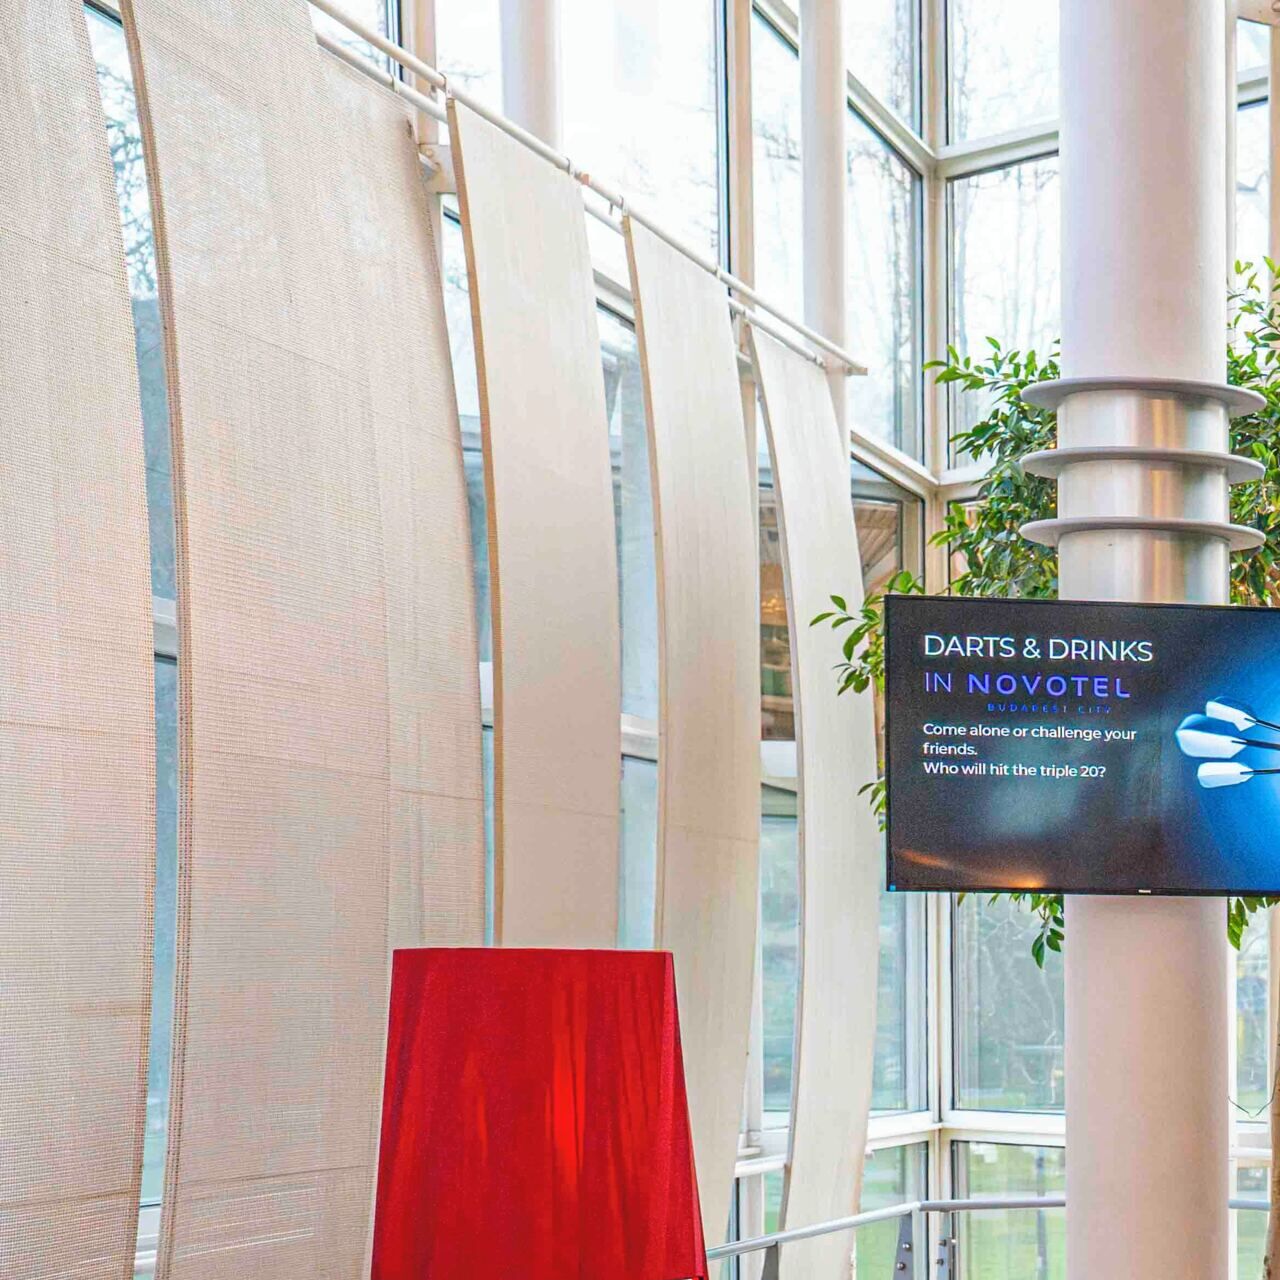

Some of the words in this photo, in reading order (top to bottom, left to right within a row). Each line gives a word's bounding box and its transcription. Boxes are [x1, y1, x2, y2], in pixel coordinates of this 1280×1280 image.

[924, 634, 1016, 660] DARTS
[1022, 638, 1041, 660] &
[1048, 638, 1153, 663] DRINKS
[924, 671, 952, 693] IN
[967, 672, 1131, 699] NOVOTEL
[923, 724, 967, 737] Come
[969, 724, 1008, 738] alone
[1011, 728, 1028, 739] or
[1031, 725, 1101, 743] challenge
[1103, 729, 1137, 744] your
[923, 742, 977, 756] friends.
[923, 762, 958, 775] Who
[960, 762, 986, 776] will
[989, 762, 1009, 776] hit
[1010, 762, 1037, 777] the
[1039, 763, 1077, 780] triple
[1079, 765, 1106, 778] 20?
